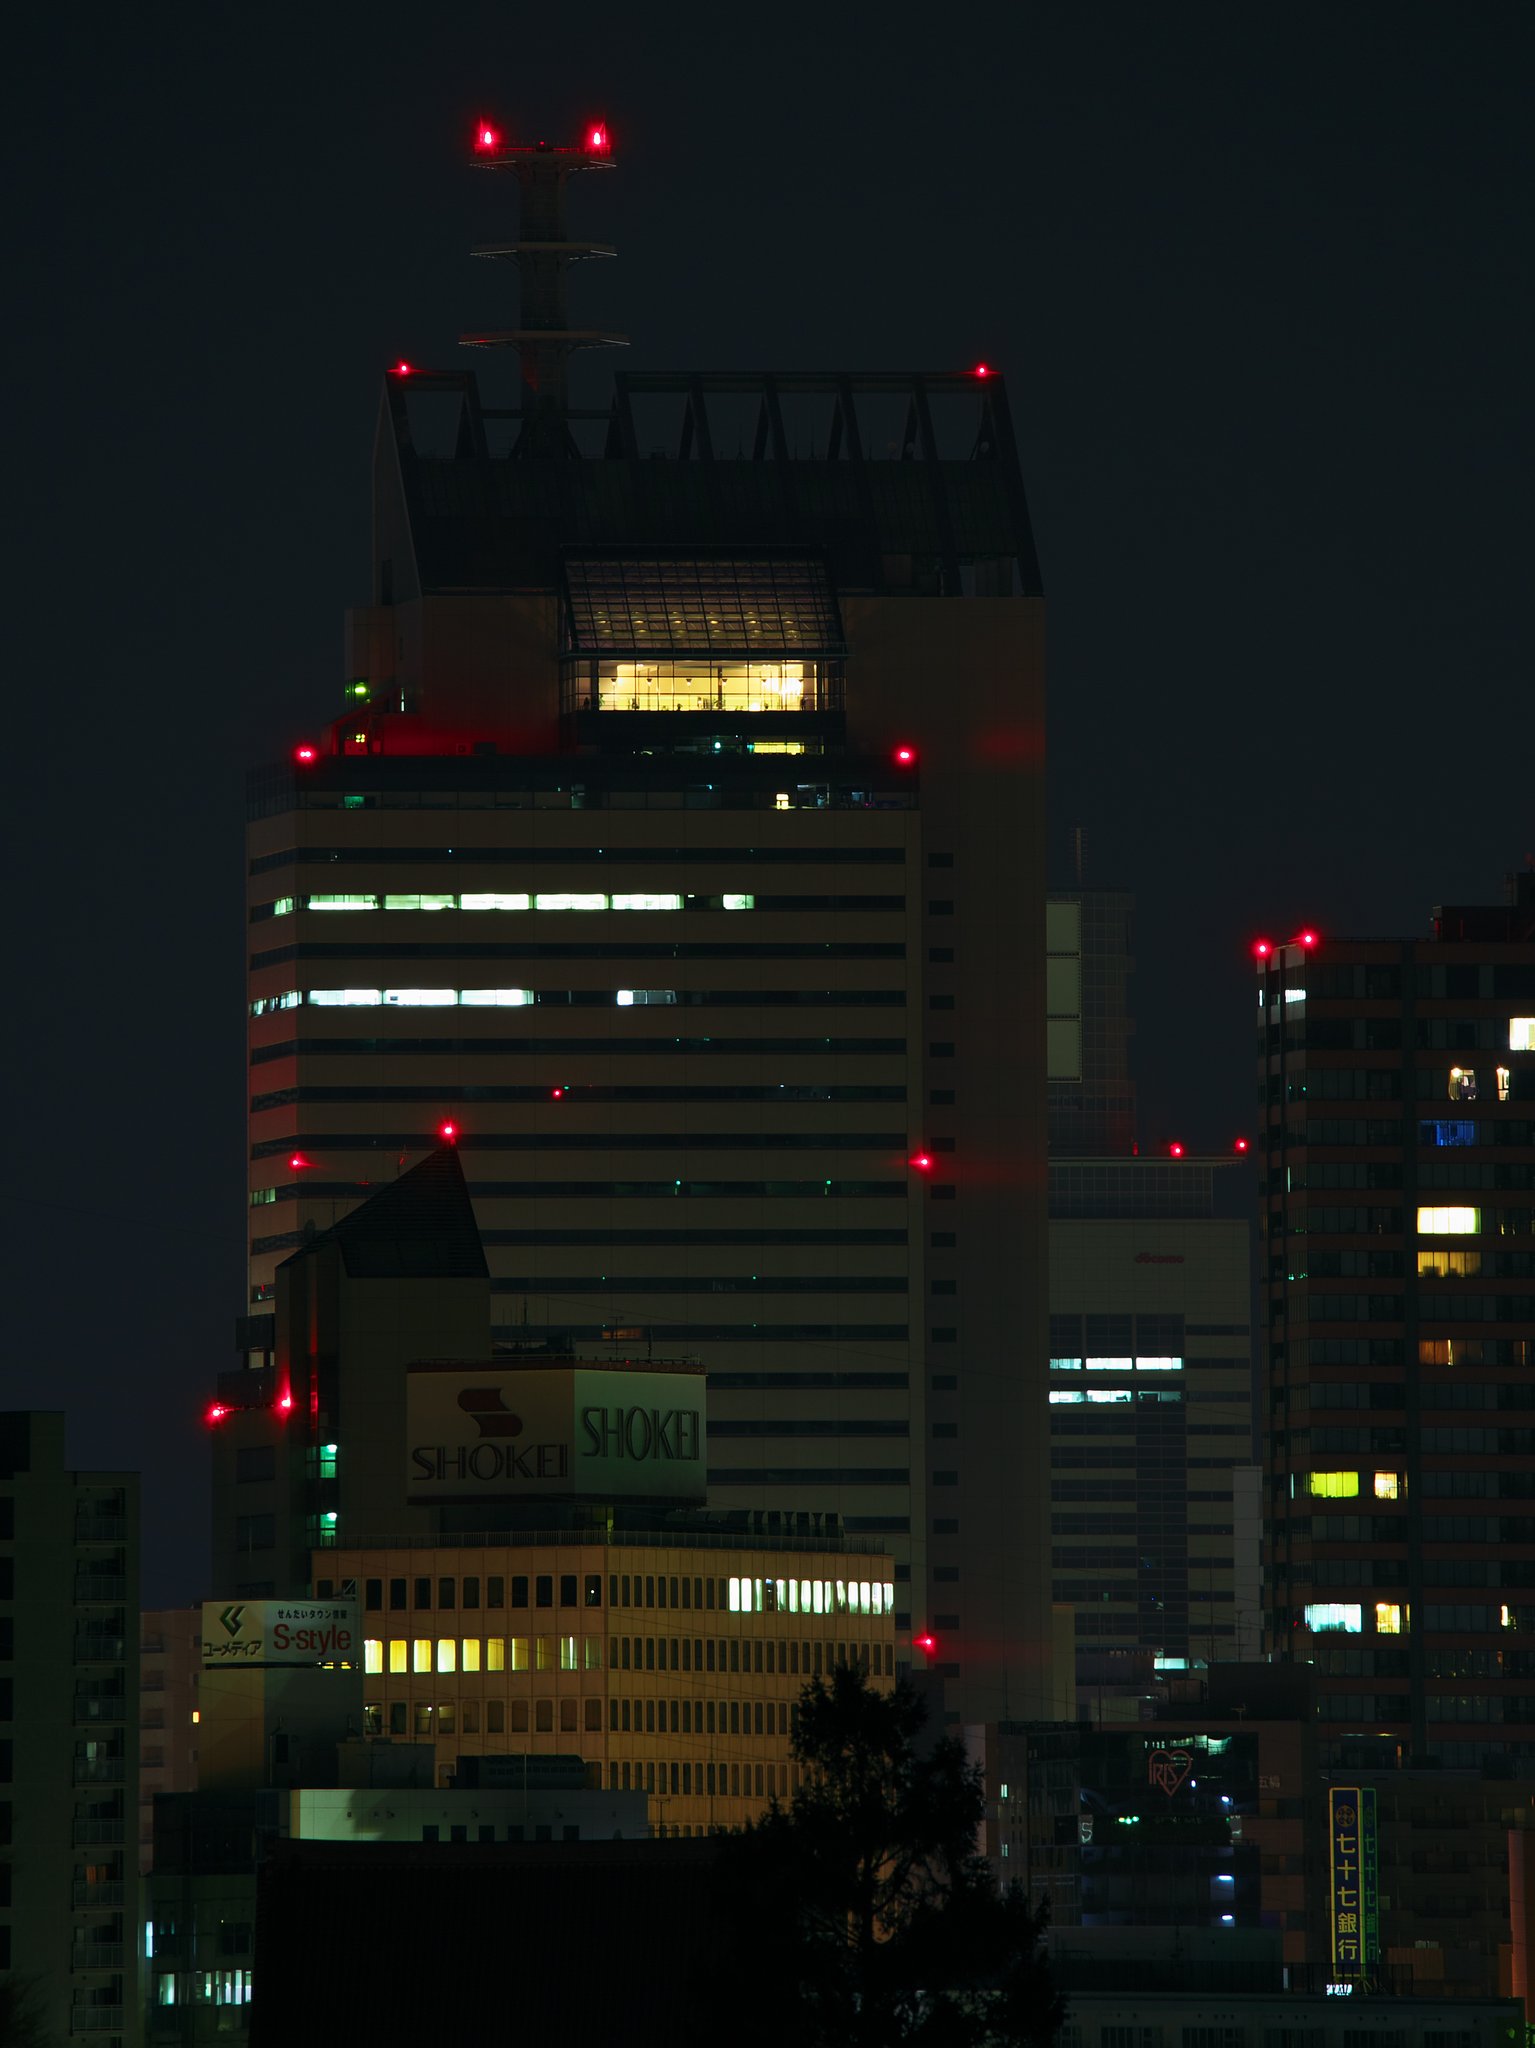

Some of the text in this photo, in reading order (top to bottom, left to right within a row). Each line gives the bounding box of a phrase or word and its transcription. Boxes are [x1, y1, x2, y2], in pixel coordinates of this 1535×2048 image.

[582, 1406, 700, 1461] SHOKEI
[412, 1443, 569, 1481] SHOKEI
[273, 1623, 351, 1656] S-style
[1336, 1832, 1358, 1961] 七十七銀行
